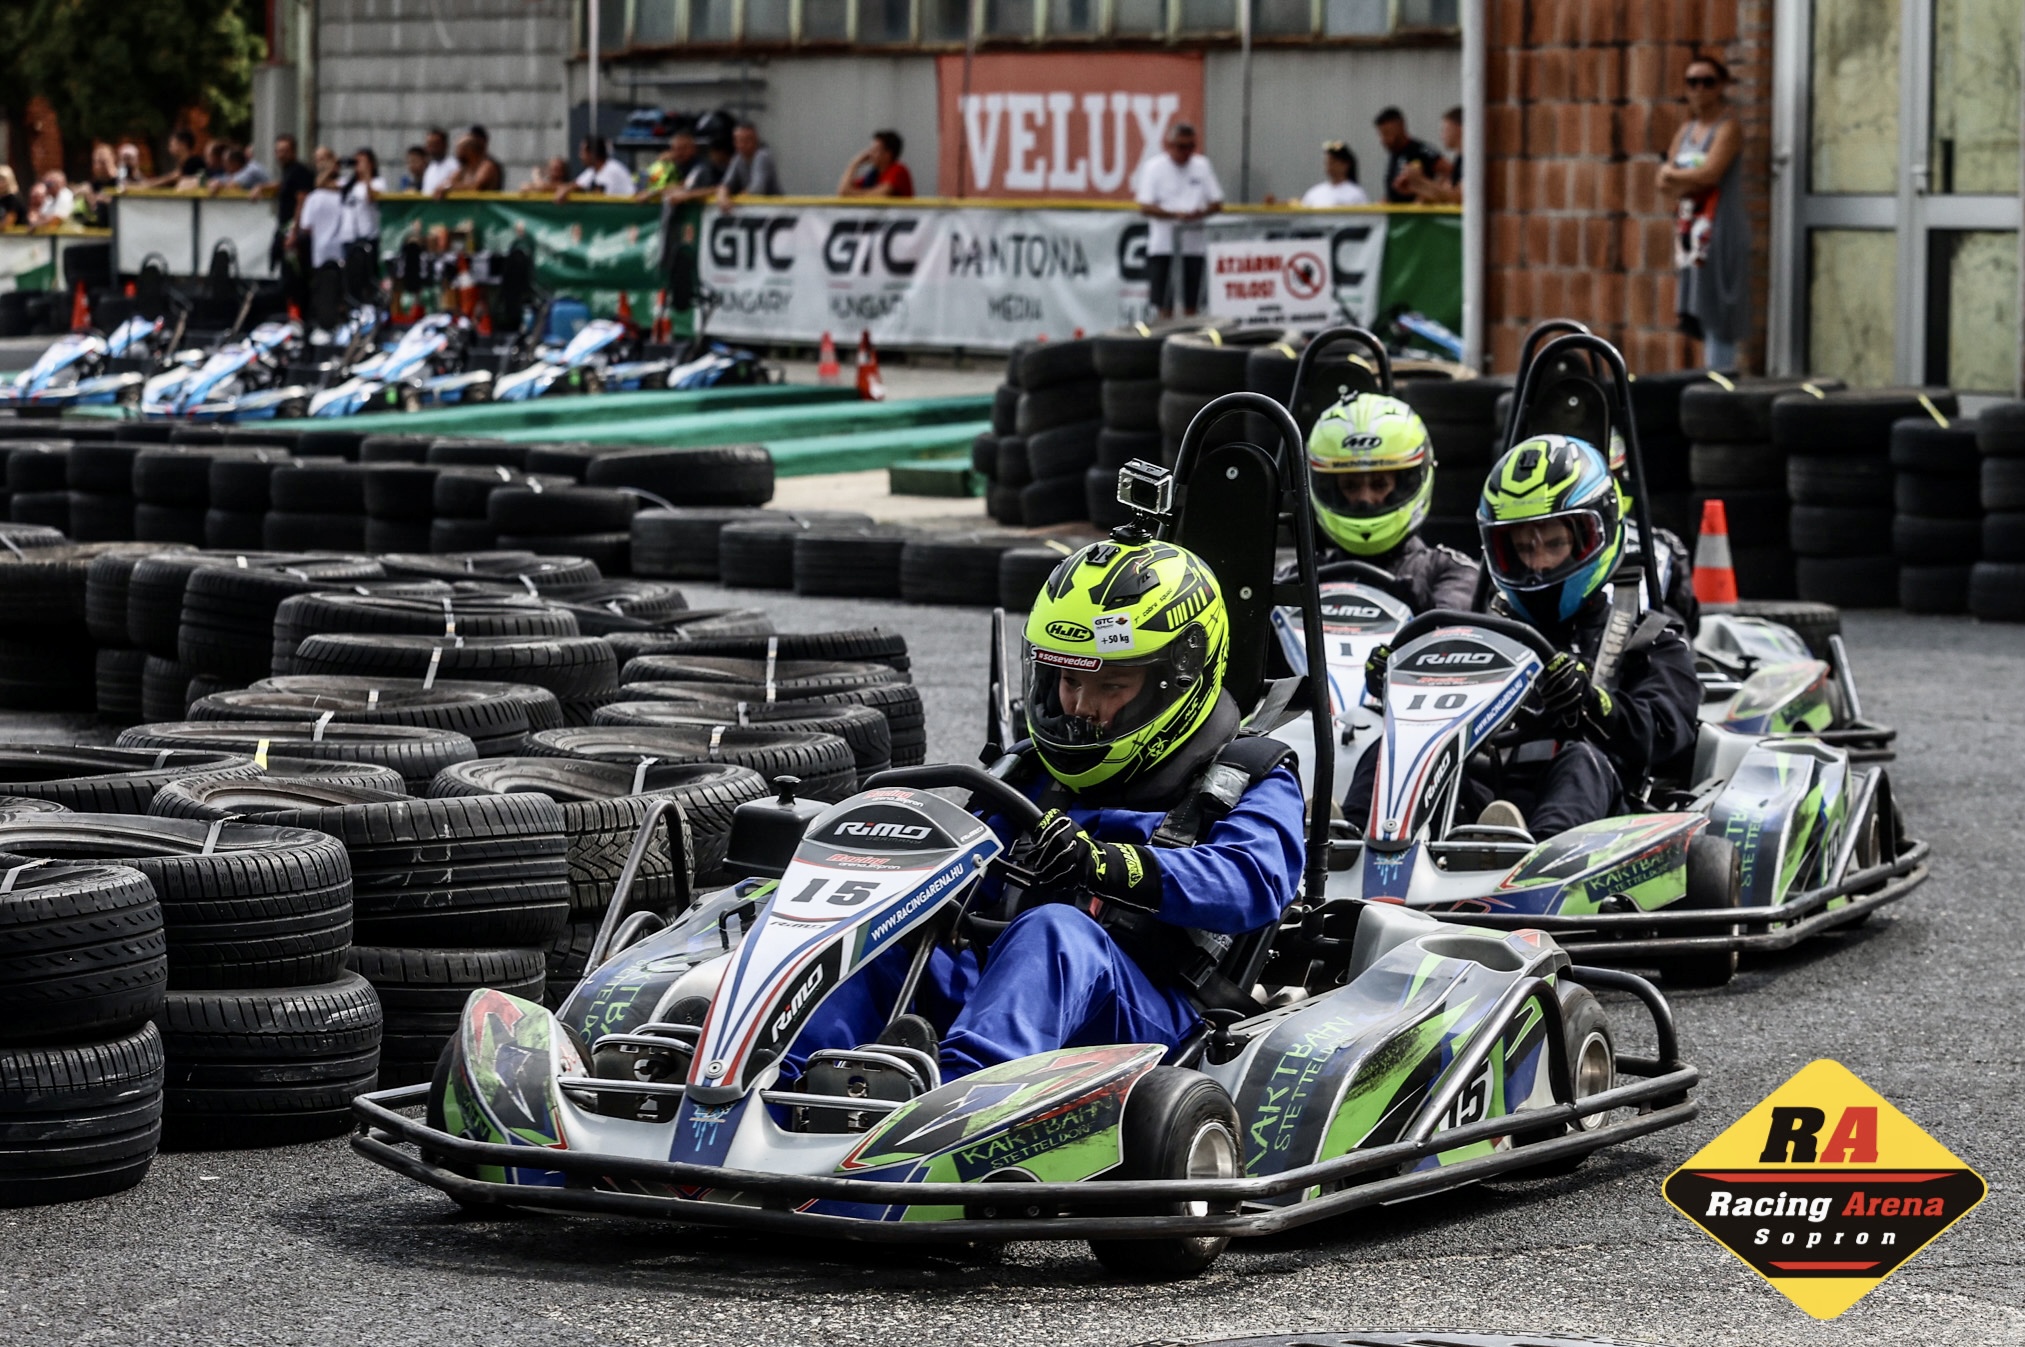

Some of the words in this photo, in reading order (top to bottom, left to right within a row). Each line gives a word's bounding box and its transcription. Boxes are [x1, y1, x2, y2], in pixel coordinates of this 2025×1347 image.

[957, 90, 1180, 192] VELUX
[710, 216, 798, 271] GTC
[824, 218, 919, 276] GTC
[1094, 616, 1114, 626] GTC
[1049, 622, 1089, 640] HJC
[1100, 634, 1118, 645] +50
[1119, 633, 1130, 644] kg
[1340, 642, 1353, 657] 1
[1037, 652, 1098, 668] #soseveddel
[1406, 693, 1468, 711] 10
[790, 878, 881, 906] 15
[870, 863, 964, 942] WWW.RACINGARENA.HU
